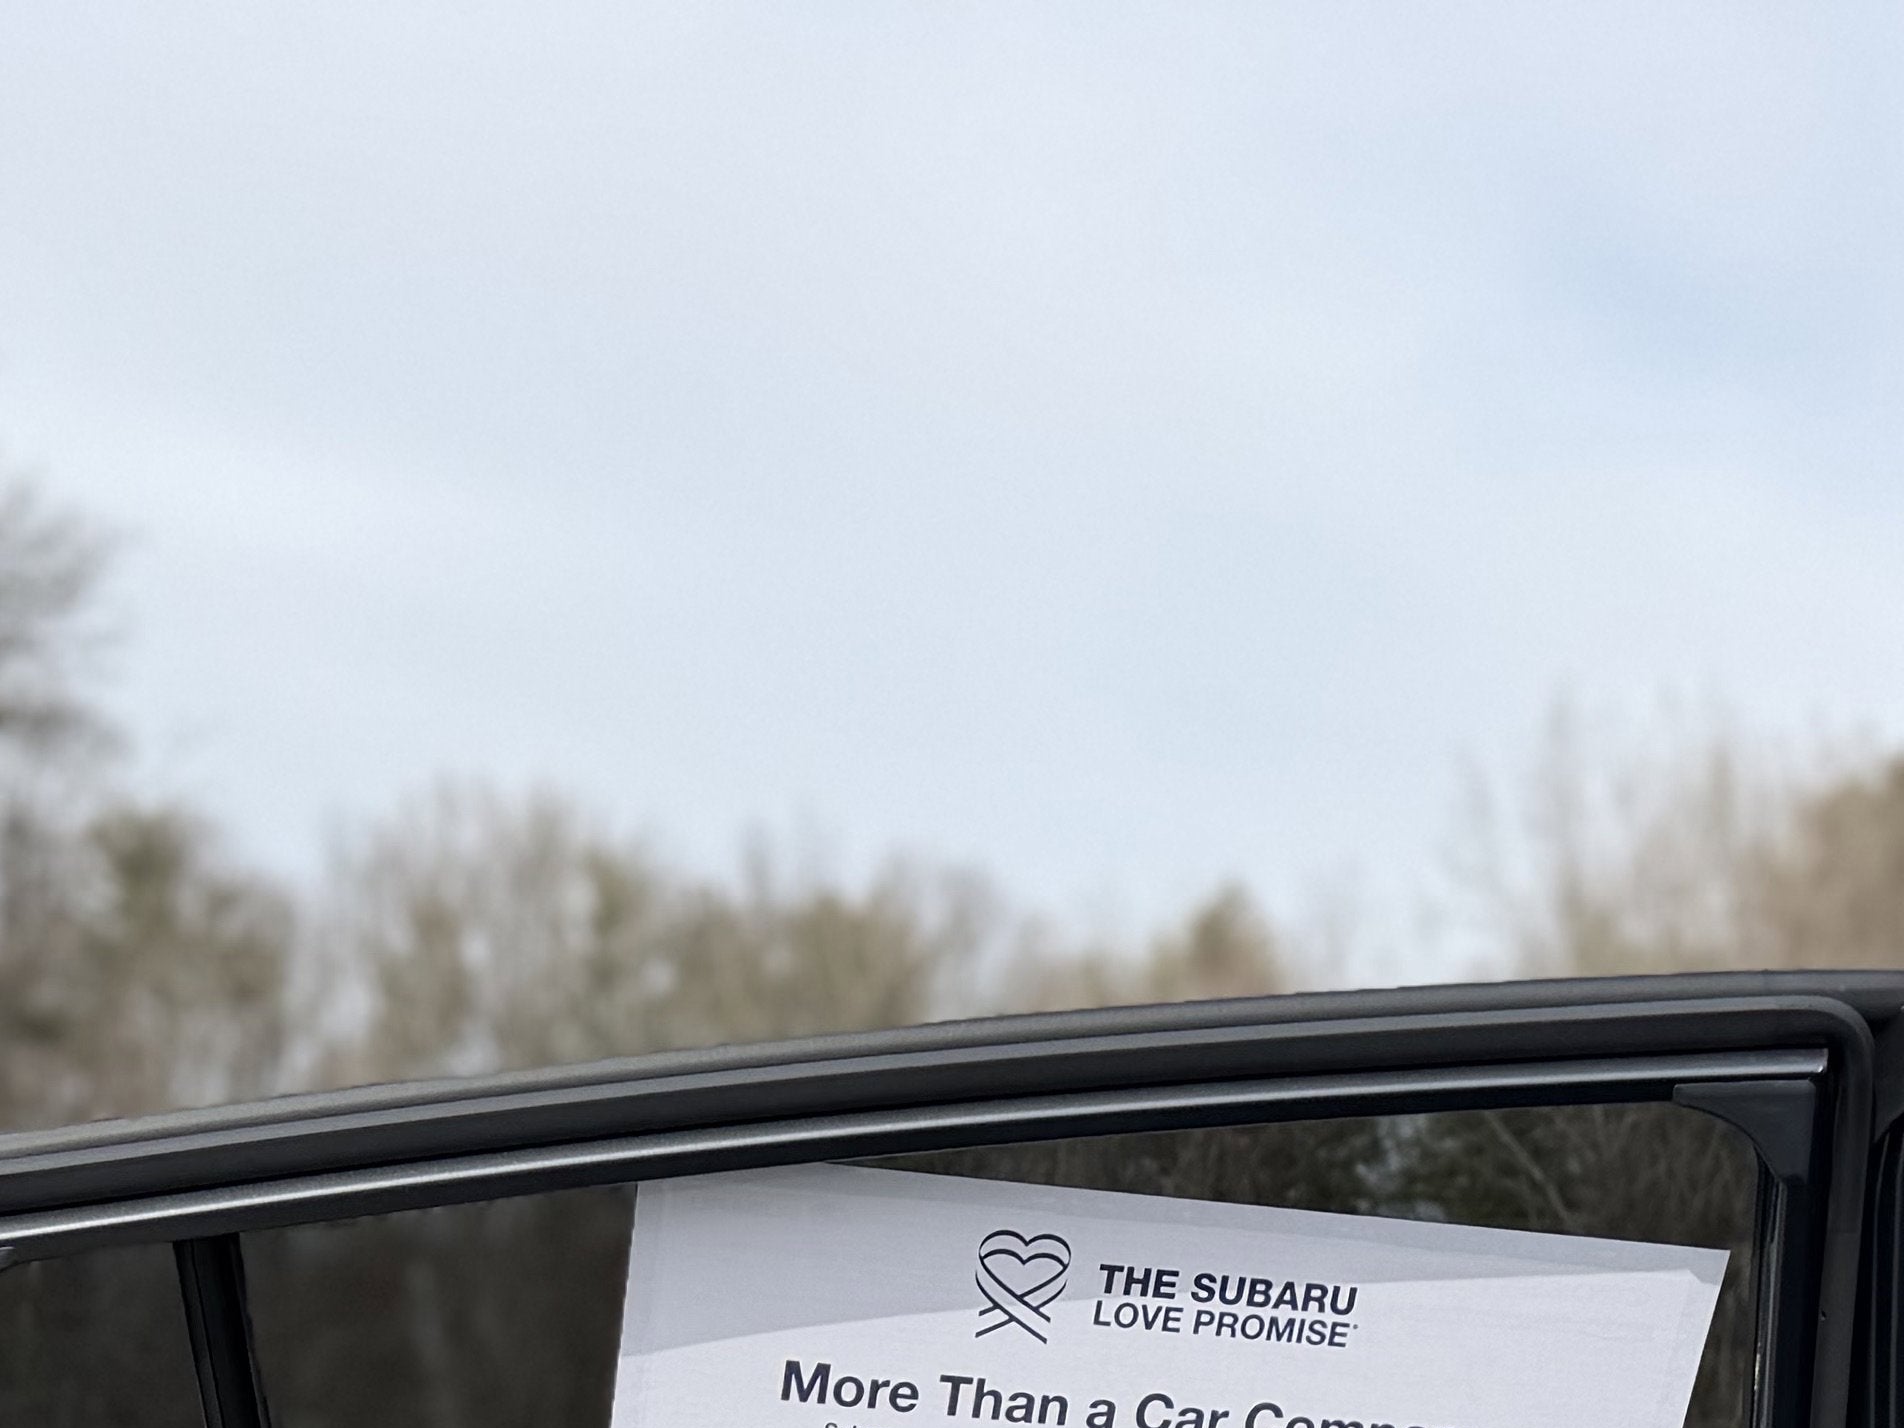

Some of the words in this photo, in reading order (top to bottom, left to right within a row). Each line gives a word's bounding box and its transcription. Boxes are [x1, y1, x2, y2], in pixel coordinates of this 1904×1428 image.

[1099, 1263, 1180, 1300] THE
[1191, 1273, 1358, 1316] SUBARU
[1093, 1300, 1184, 1333] LOVE
[1193, 1309, 1359, 1348] PROMISE
[780, 1359, 919, 1413] More
[939, 1374, 1068, 1426] Than
